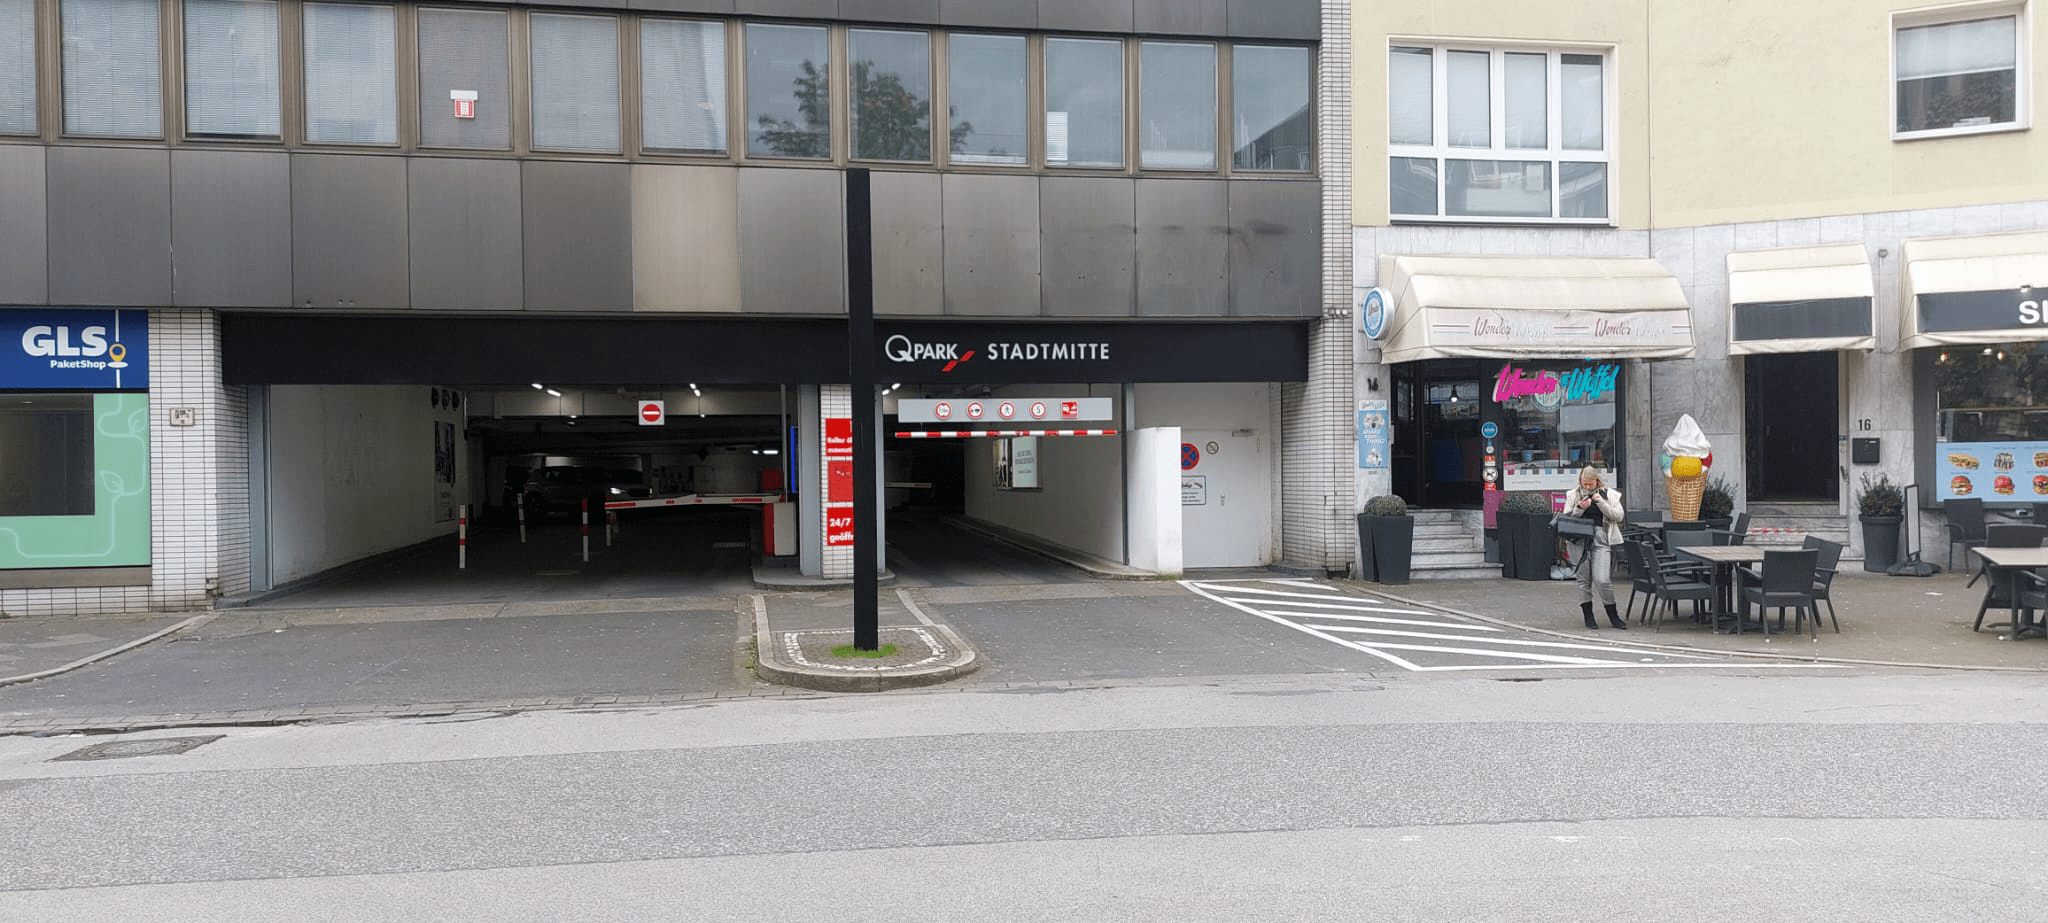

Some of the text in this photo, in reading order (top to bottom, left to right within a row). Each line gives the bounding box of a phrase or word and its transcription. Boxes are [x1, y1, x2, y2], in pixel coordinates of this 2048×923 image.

[1473, 316, 1511, 338] Wonder
[1594, 317, 1632, 337] Wonder
[22, 325, 108, 356] GLS
[987, 343, 1110, 360] STADTMITTE
[49, 360, 106, 370] PaketShop
[1367, 377, 1379, 392] 16
[1493, 364, 1558, 402] Wonder
[1858, 419, 1872, 431] 16
[829, 518, 851, 528] 24/7
